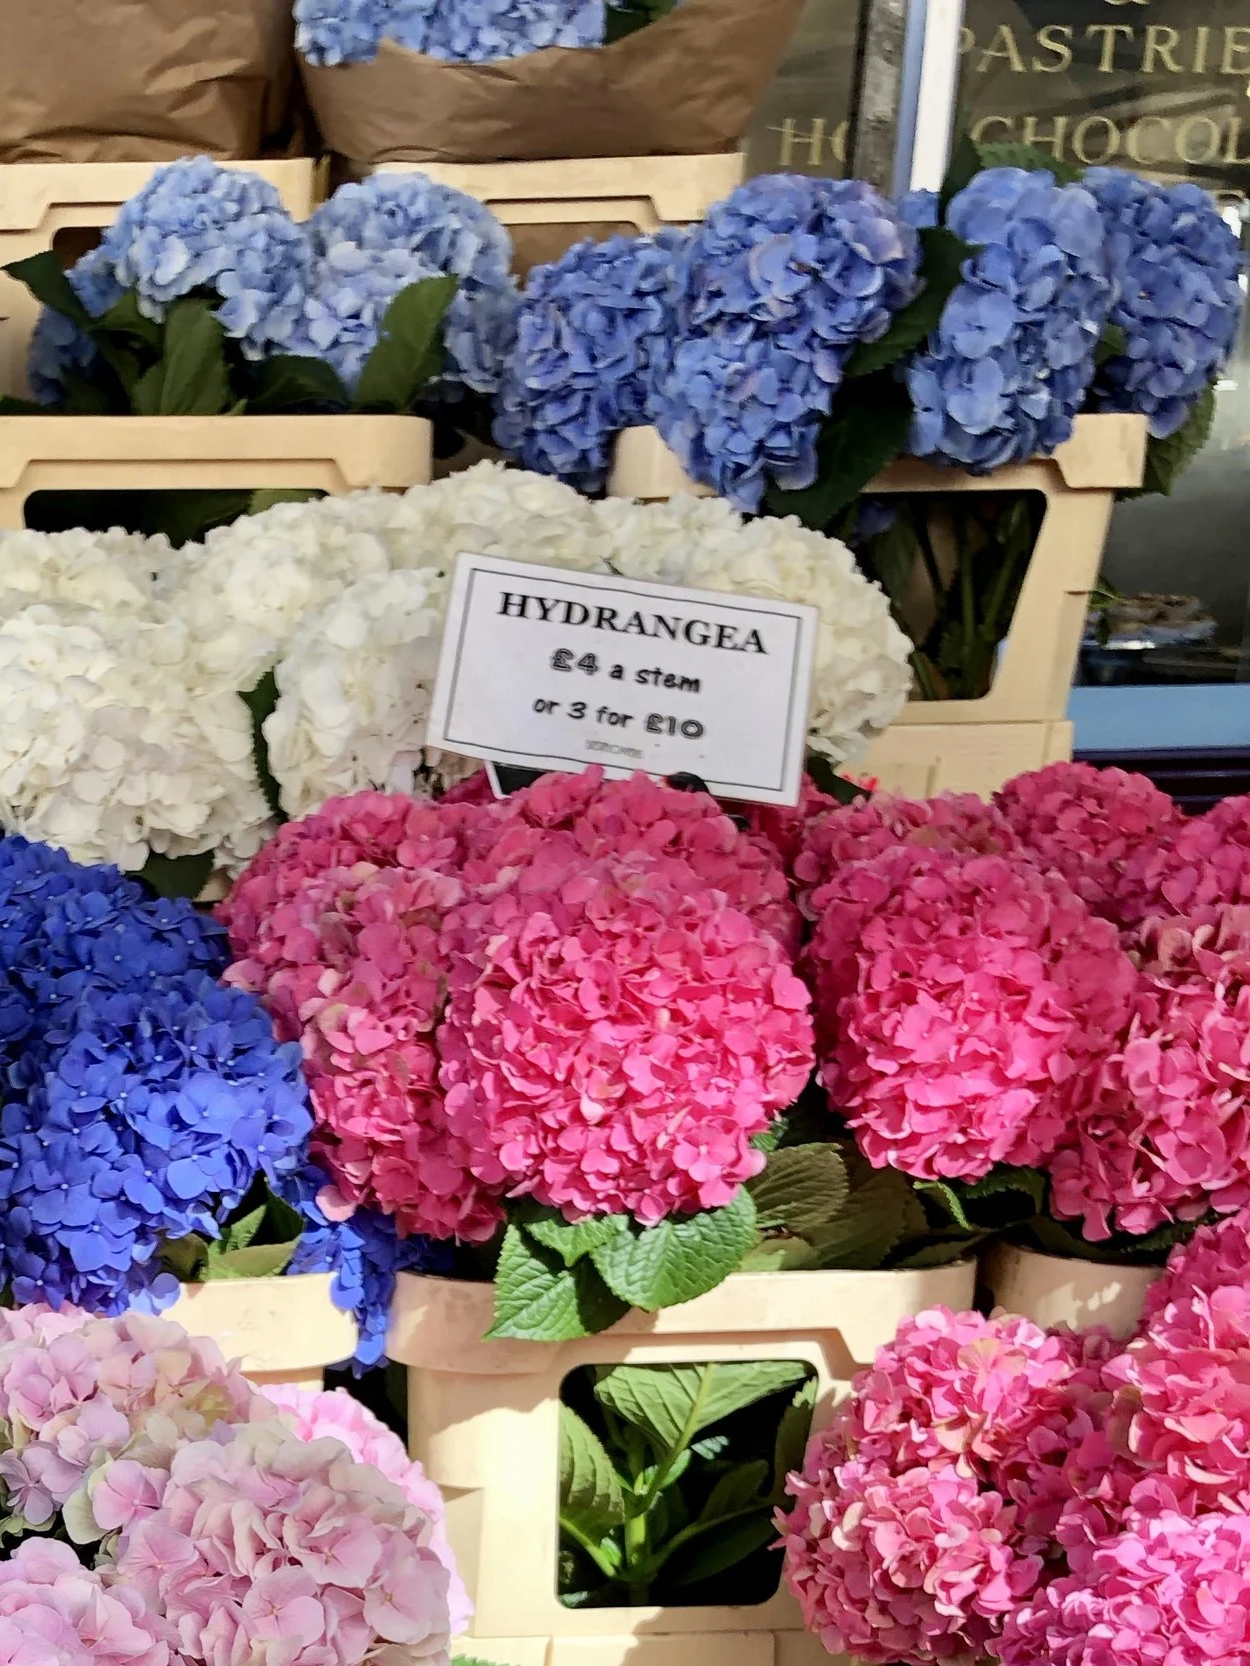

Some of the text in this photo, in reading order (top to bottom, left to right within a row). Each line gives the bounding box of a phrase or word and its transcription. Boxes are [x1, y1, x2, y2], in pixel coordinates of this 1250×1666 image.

[496, 591, 769, 655] HYDRANGEA
[549, 648, 702, 694] £4 a stem
[533, 697, 706, 740] or 3 for £10
